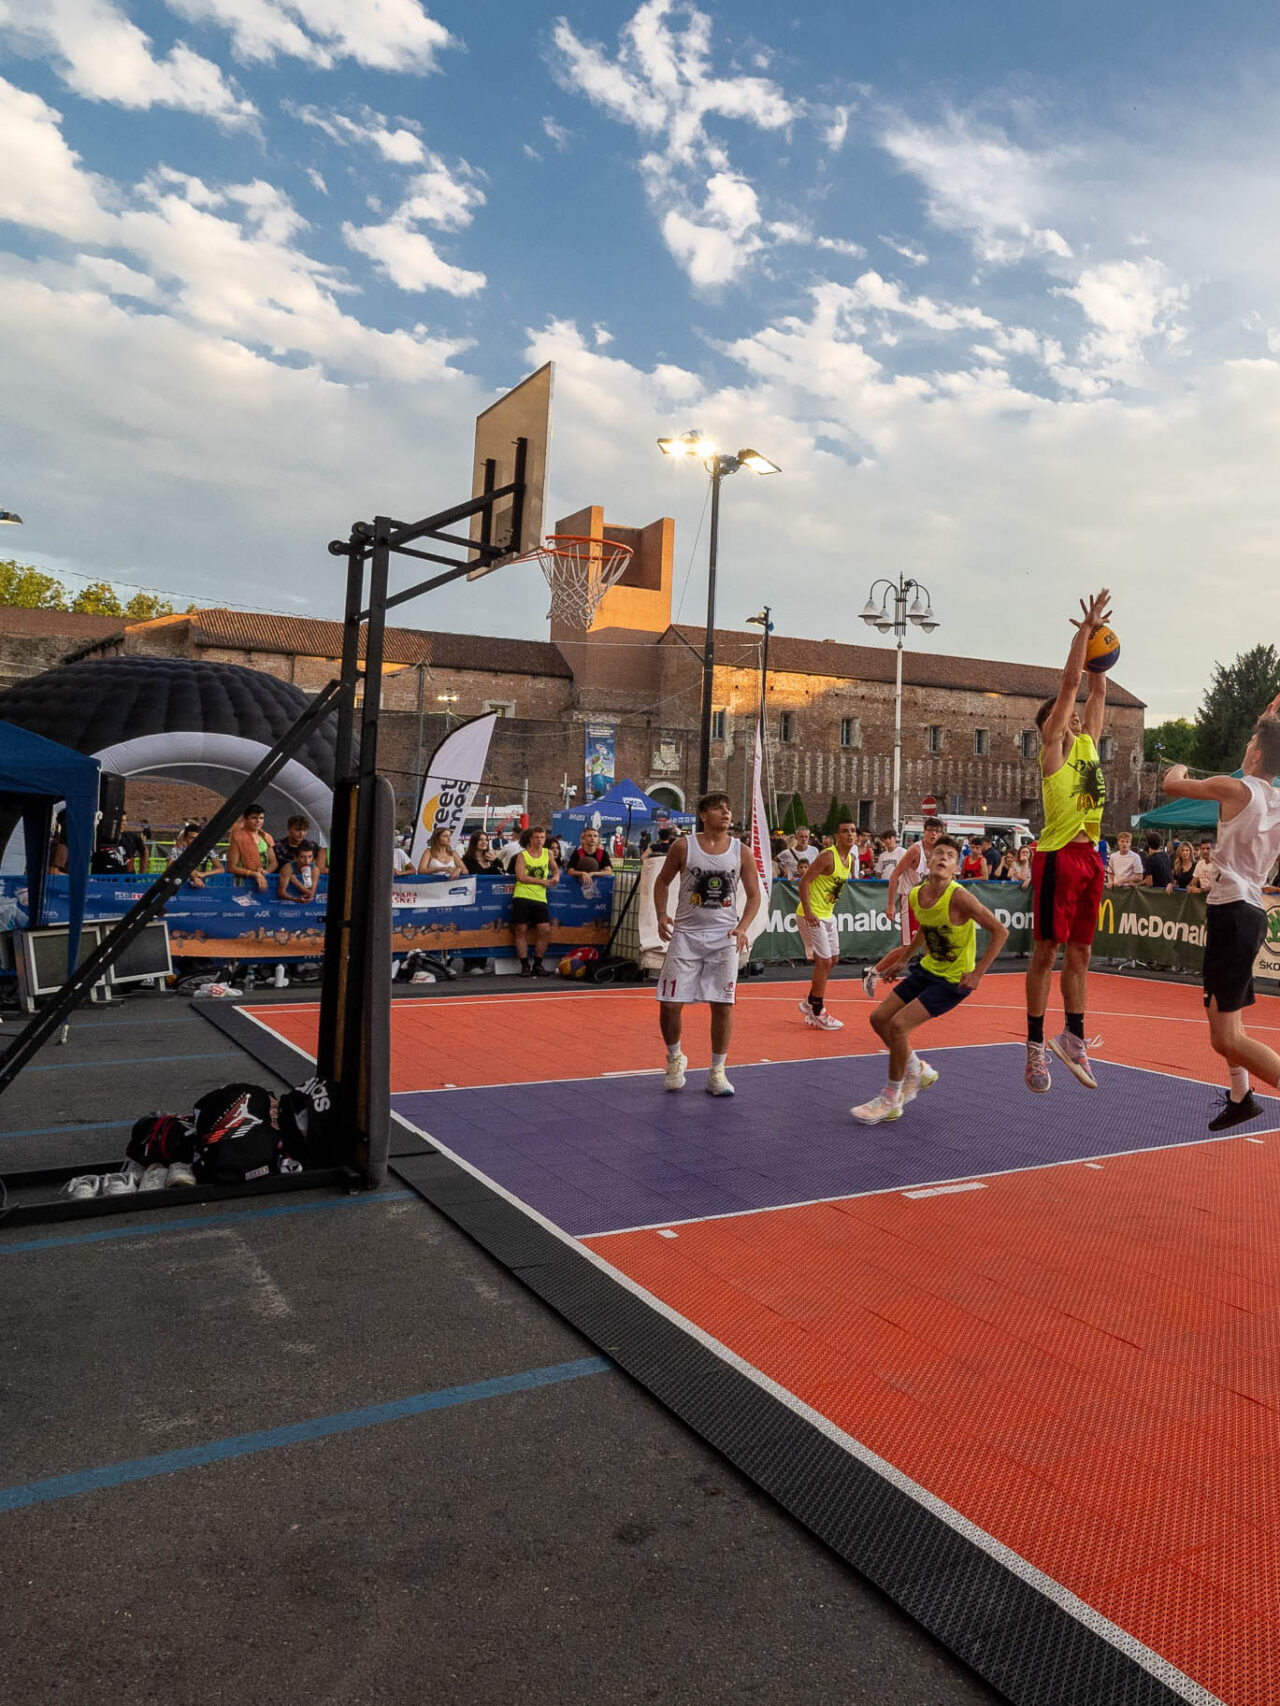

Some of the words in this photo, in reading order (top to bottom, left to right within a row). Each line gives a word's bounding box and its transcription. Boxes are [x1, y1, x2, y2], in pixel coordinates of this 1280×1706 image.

[765, 908, 901, 933] Mcnalds
[1118, 912, 1207, 948] McDonal
[662, 977, 677, 998] 11
